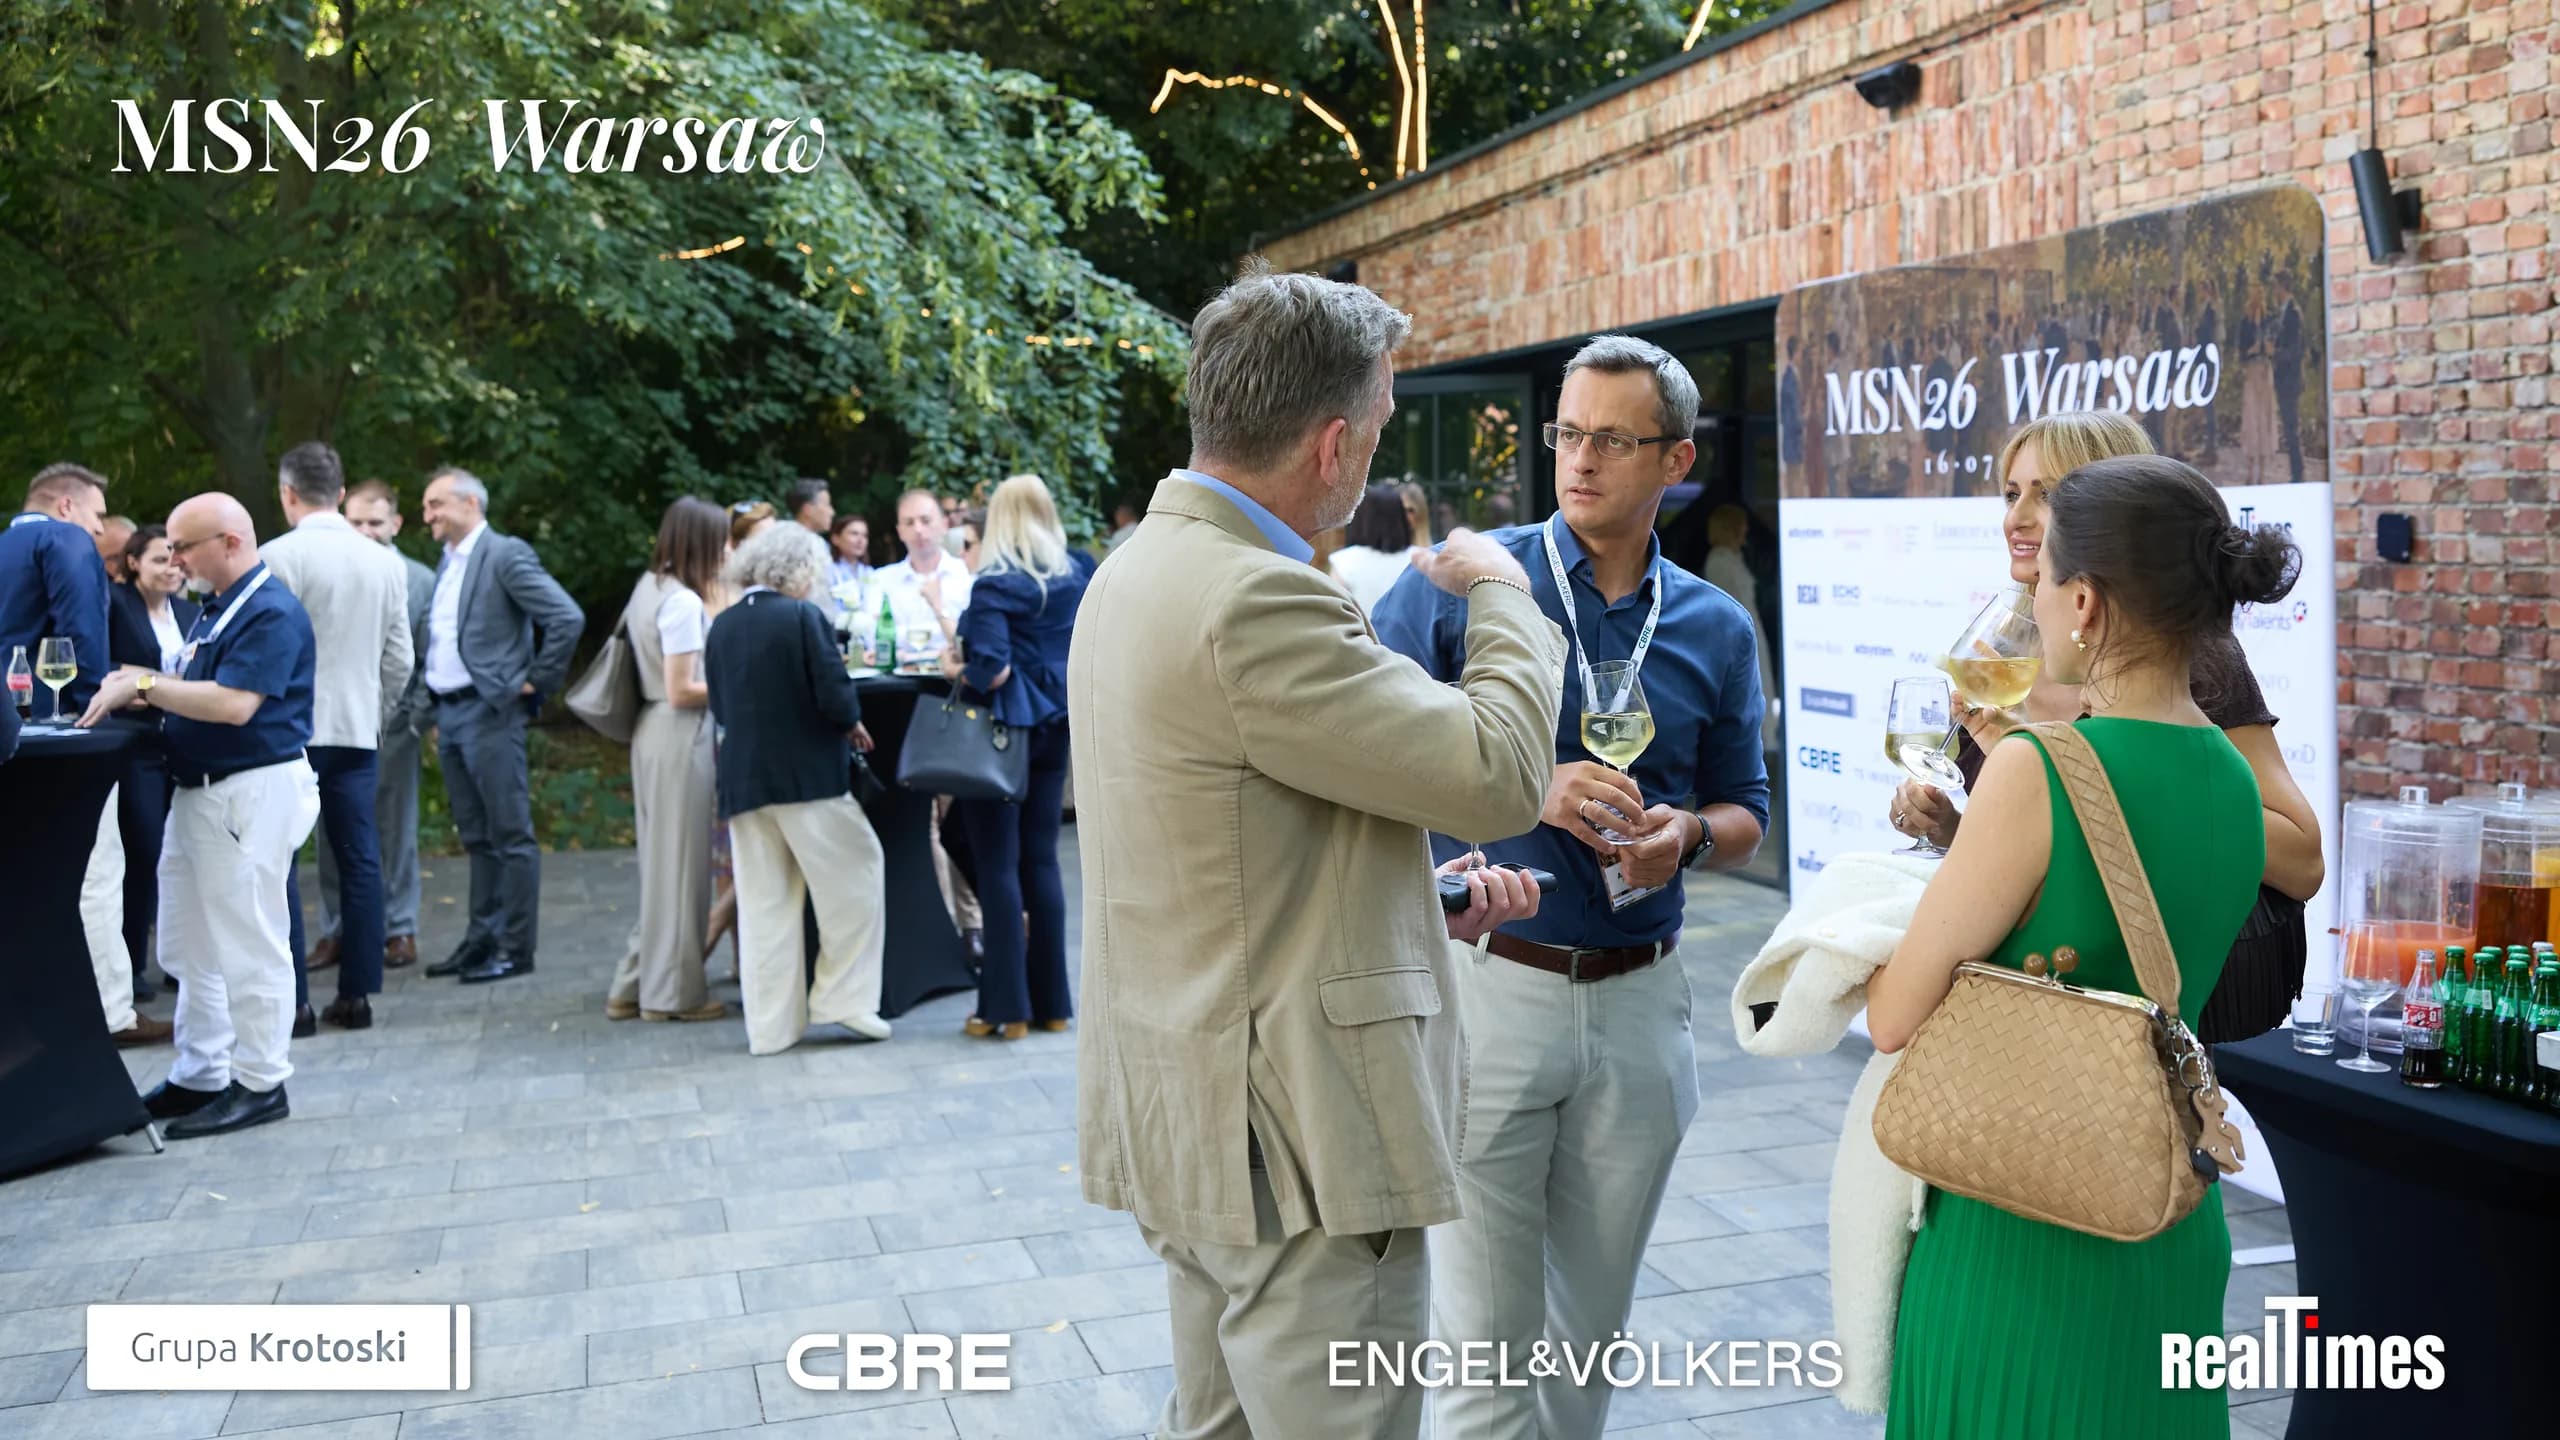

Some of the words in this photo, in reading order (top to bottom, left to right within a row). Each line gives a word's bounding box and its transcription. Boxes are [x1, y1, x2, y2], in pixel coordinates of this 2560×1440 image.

[1825, 356, 1979, 437] MSN26
[2001, 342, 2221, 427] Warsaw
[1638, 624, 1653, 650] CBRE
[1799, 745, 1842, 774] CBRE
